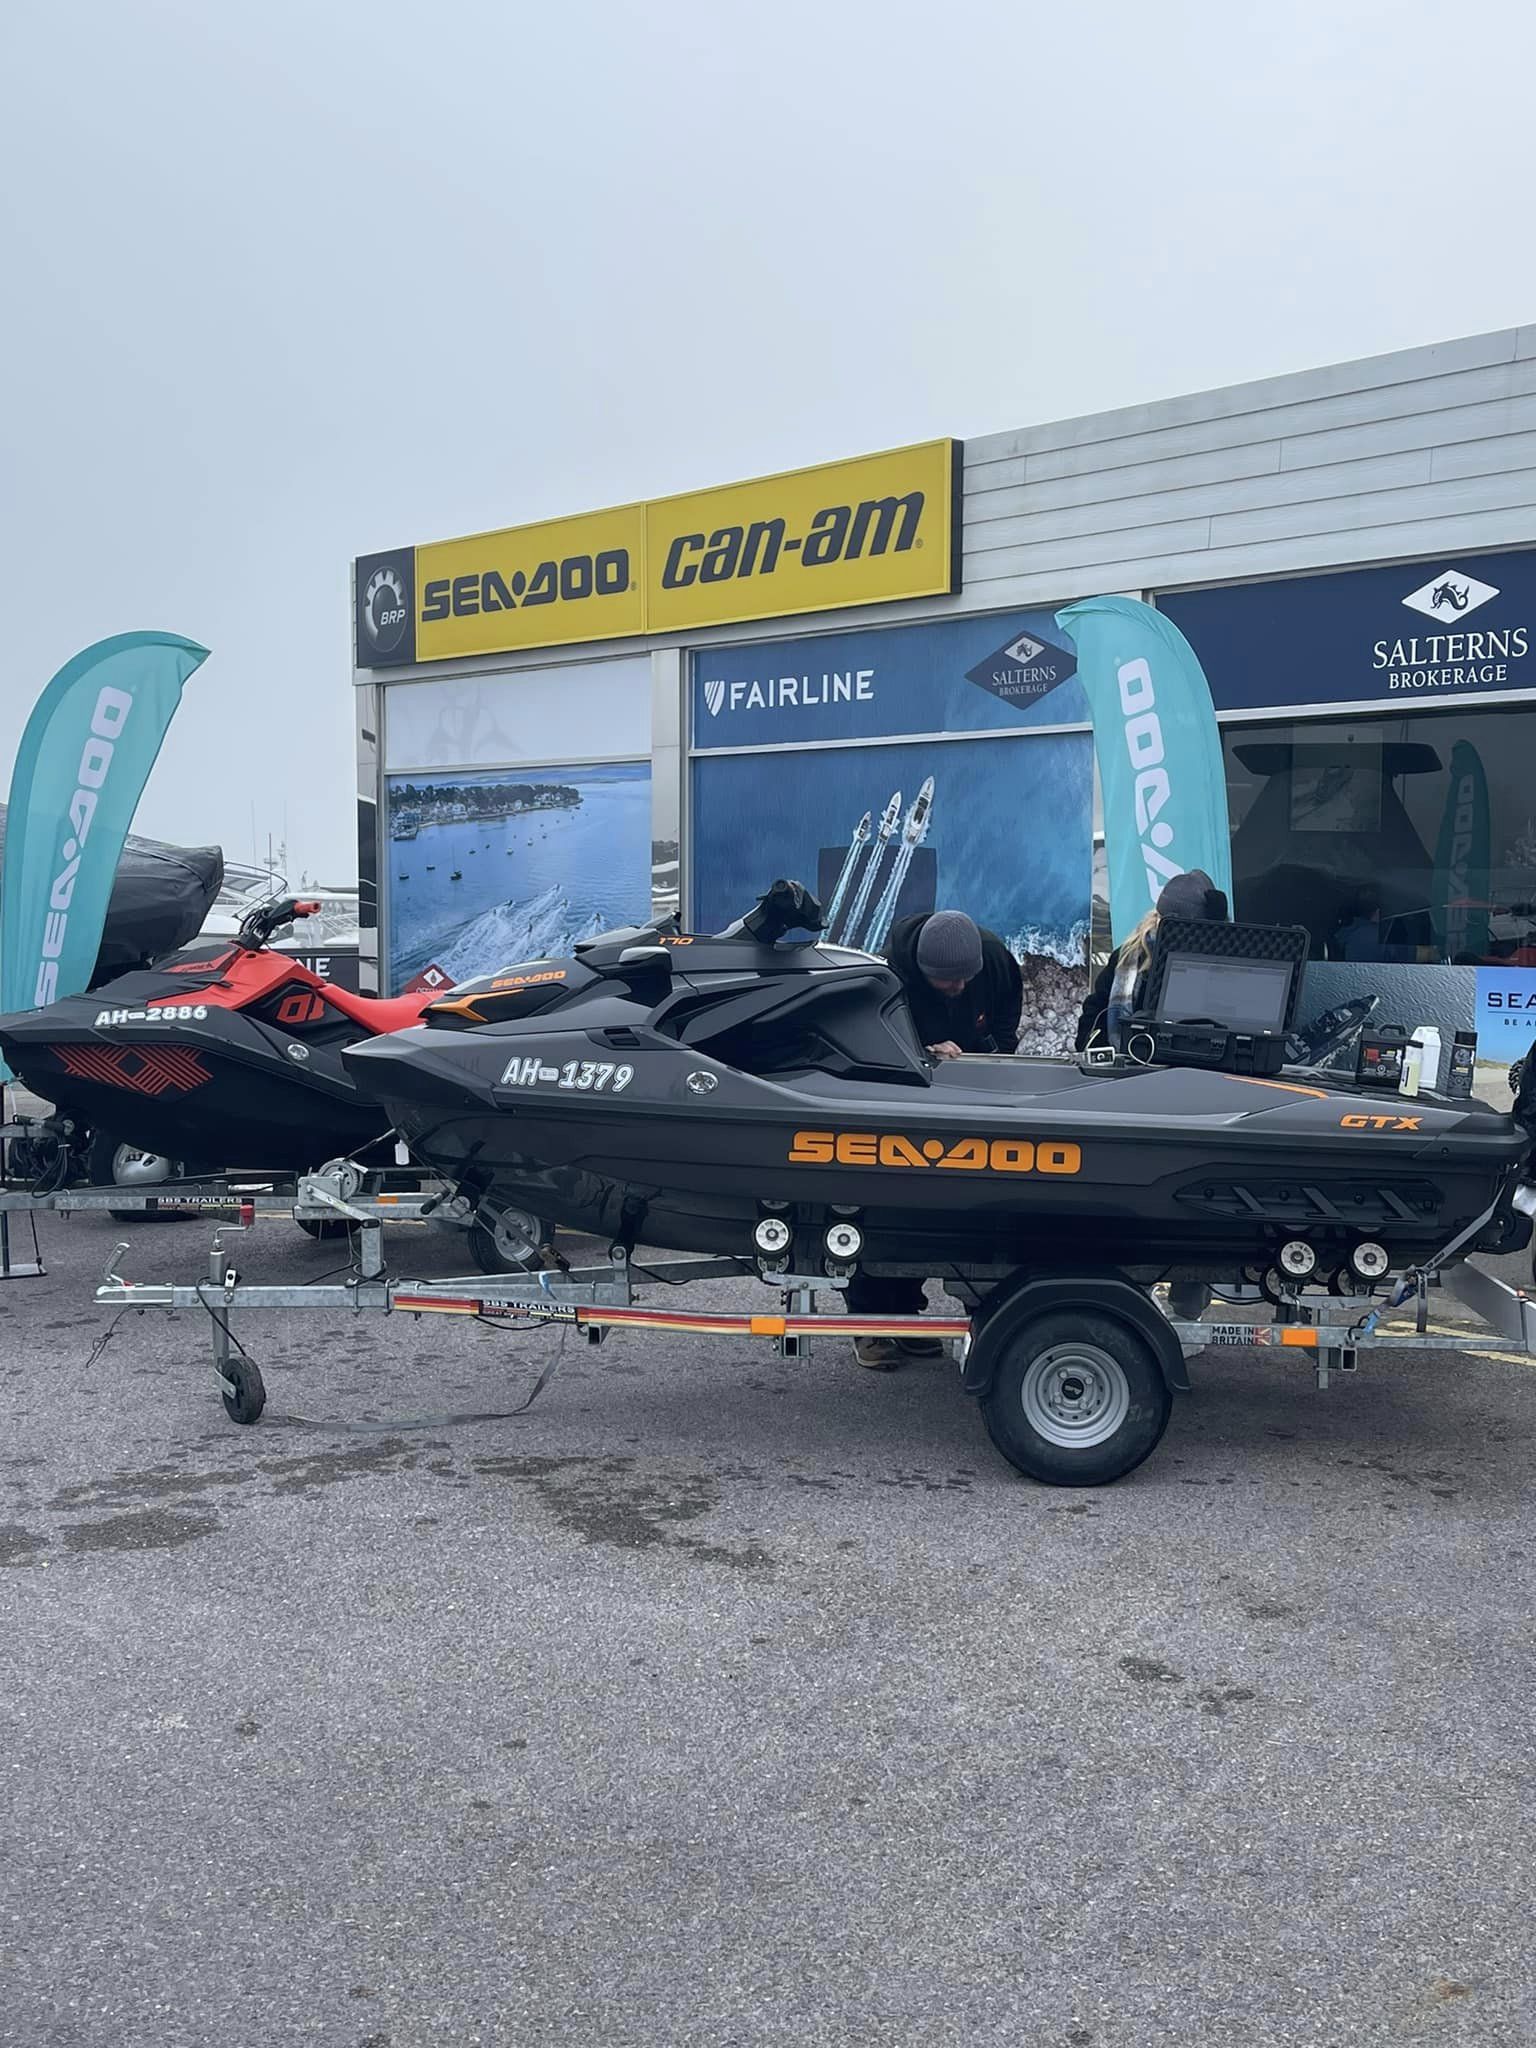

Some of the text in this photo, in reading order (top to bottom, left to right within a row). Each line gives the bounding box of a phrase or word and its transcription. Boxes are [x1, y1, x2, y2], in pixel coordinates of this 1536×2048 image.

[380, 608, 406, 625] BRP
[1372, 627, 1529, 669] SALTERNS
[991, 665, 1057, 687] SALTERNS
[1388, 664, 1507, 689] BROKERAGE
[730, 670, 875, 711] FAIRLINE
[999, 682, 1048, 697] BROKERAGE
[659, 936, 694, 946] 170
[94, 1005, 208, 1026] AH-2886
[501, 1056, 635, 1092] AH-1379
[1340, 1114, 1425, 1131] GTX
[1212, 1326, 1254, 1336] MADE IN
[1212, 1335, 1255, 1346] BRITAIN
